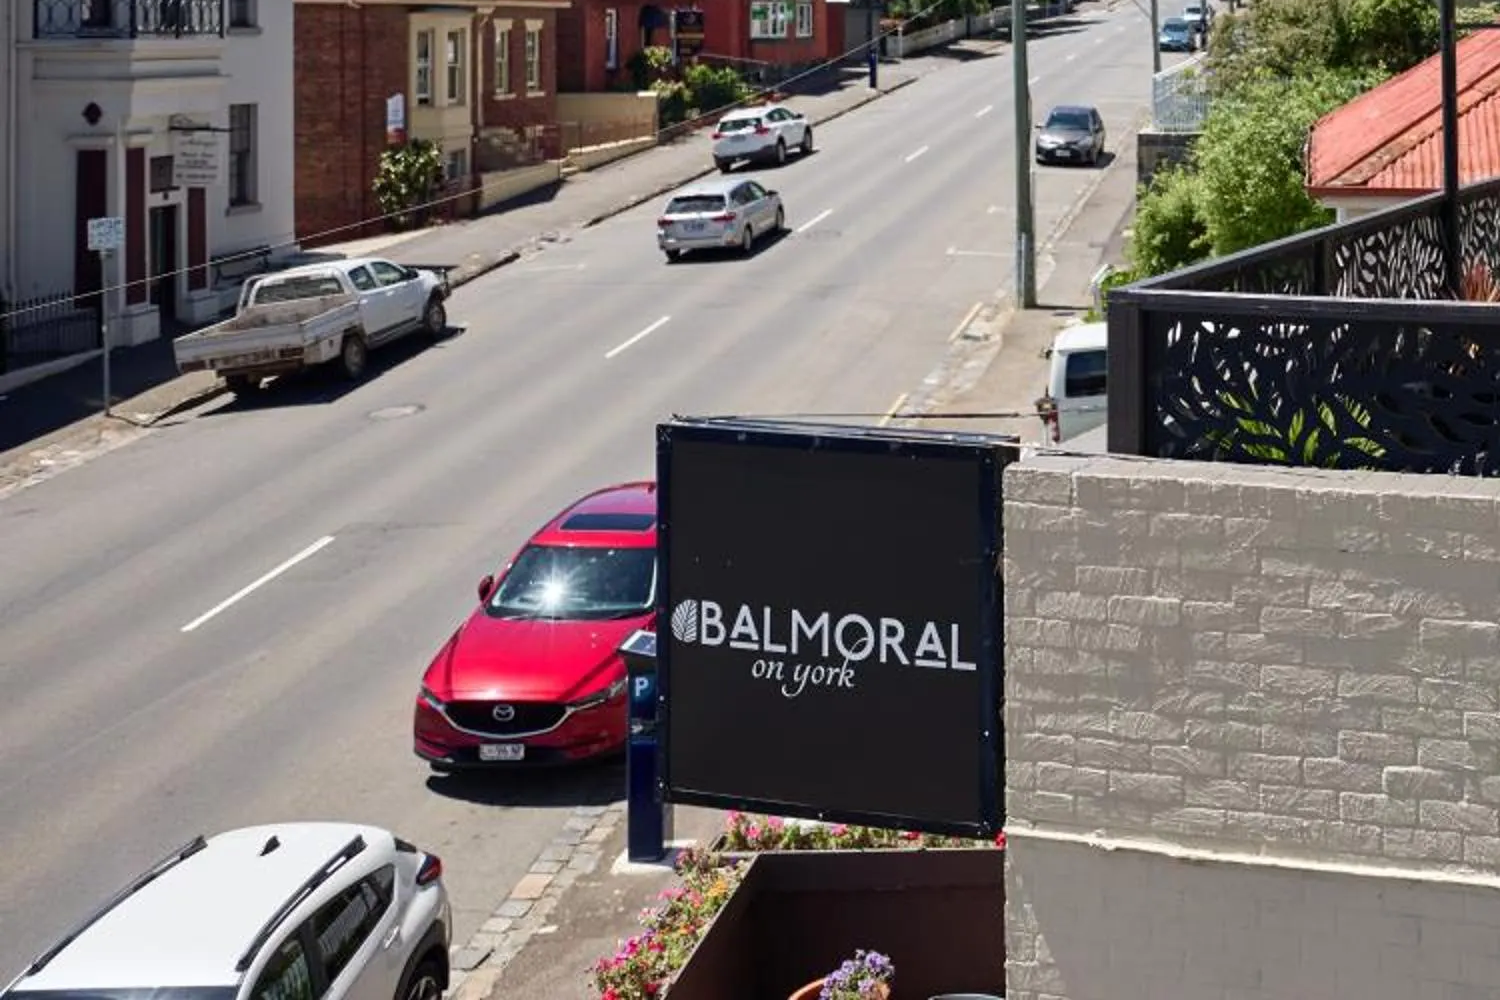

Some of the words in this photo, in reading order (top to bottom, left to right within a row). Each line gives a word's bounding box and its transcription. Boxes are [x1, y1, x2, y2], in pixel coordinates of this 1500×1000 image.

[700, 600, 977, 671] BALMORAL
[634, 676, 650, 698] P
[751, 659, 784, 681] on
[781, 655, 856, 697] york
